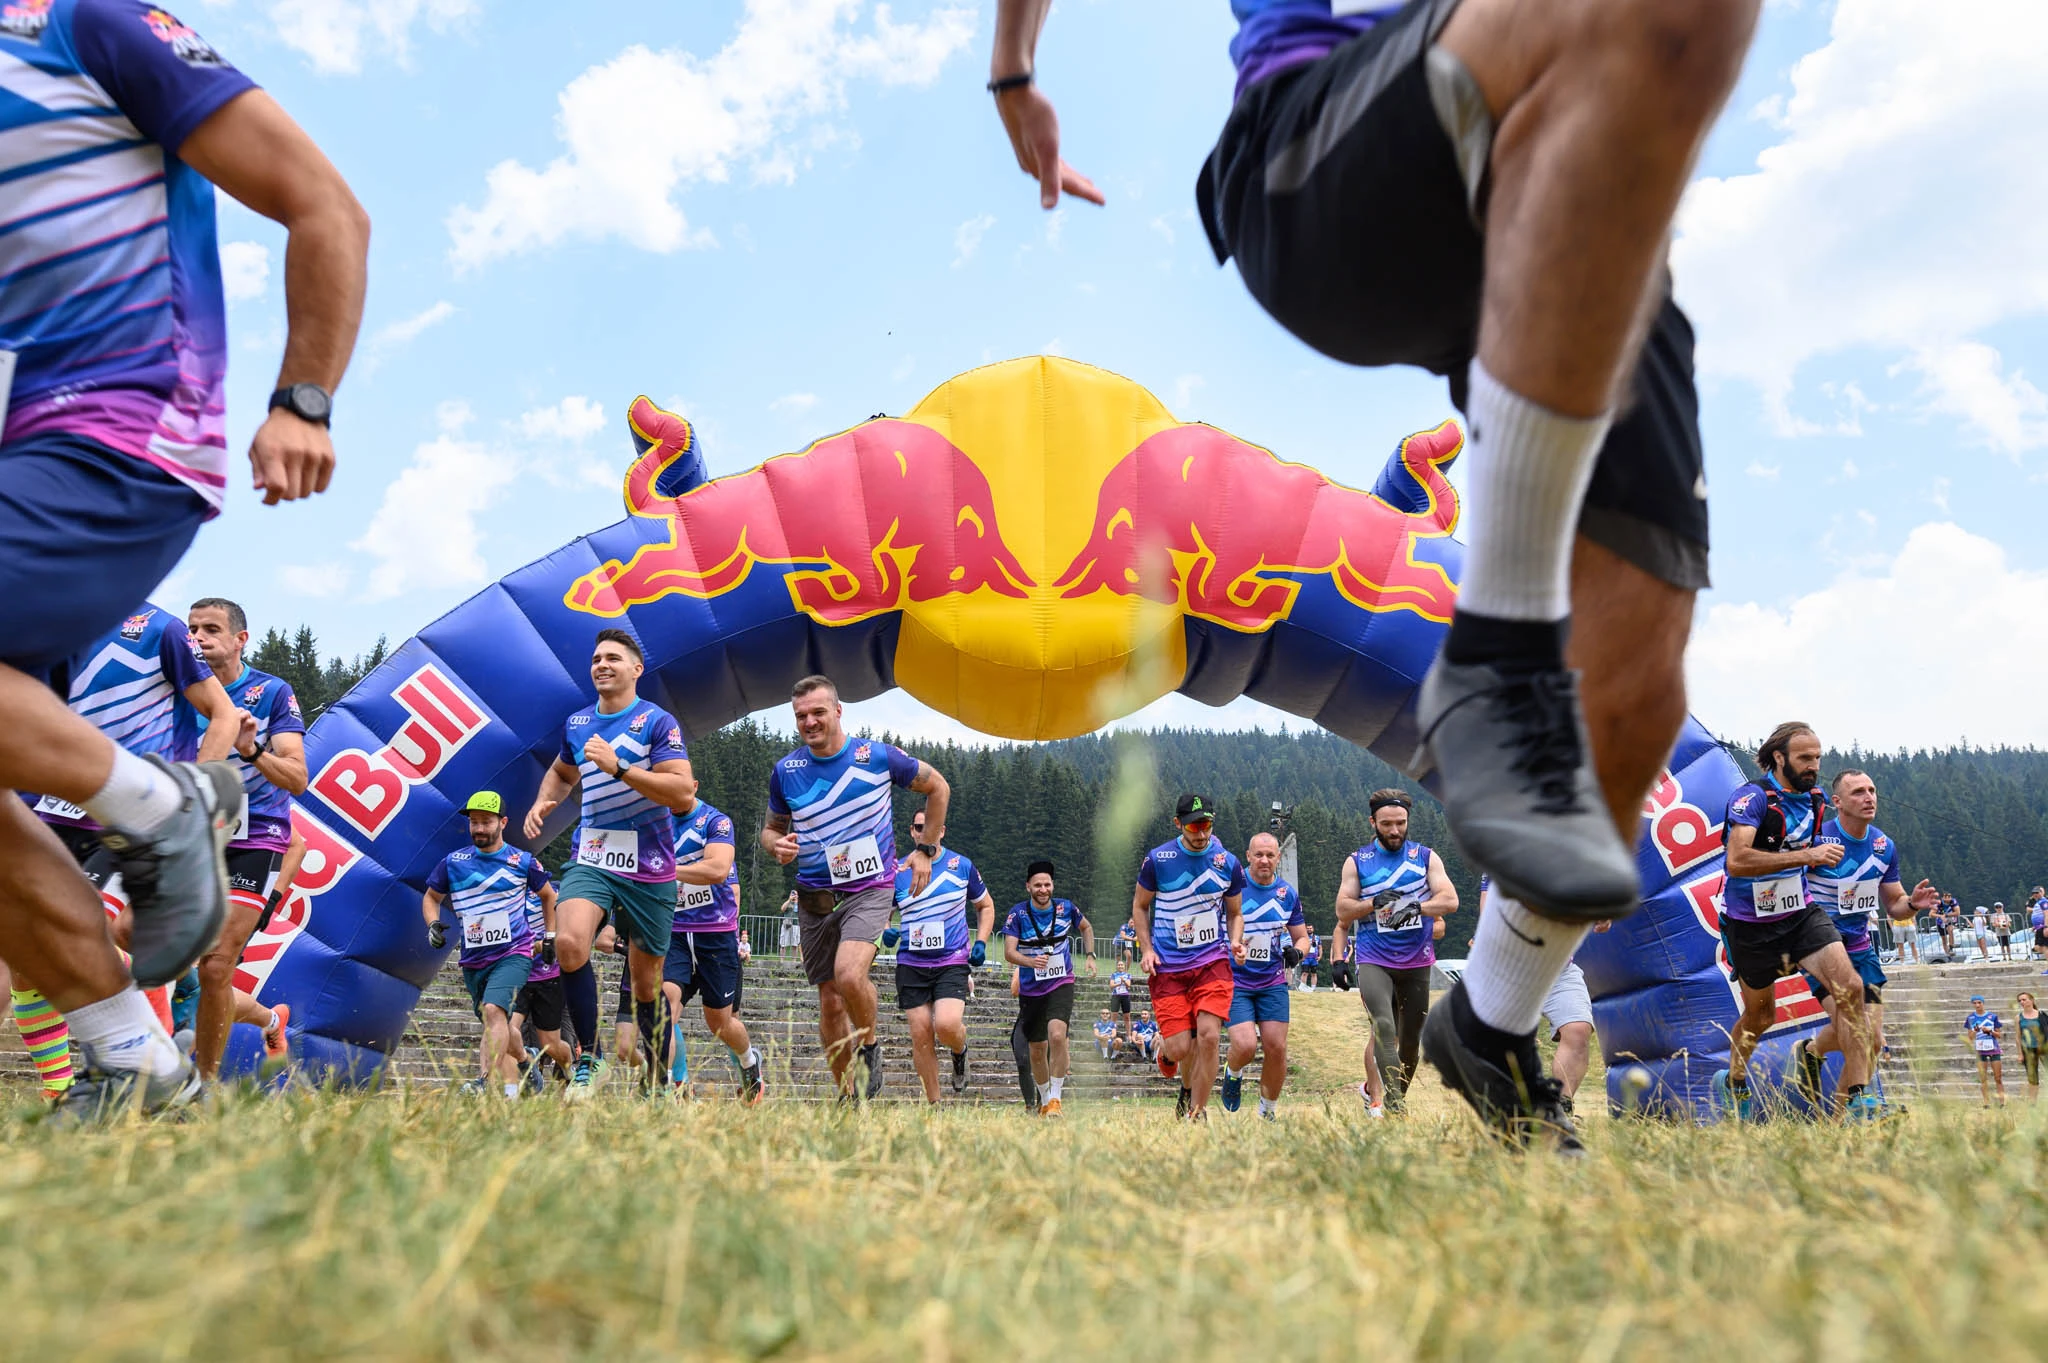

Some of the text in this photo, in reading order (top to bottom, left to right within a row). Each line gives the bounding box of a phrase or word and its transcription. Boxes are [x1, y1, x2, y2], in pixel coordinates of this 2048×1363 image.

[310, 665, 487, 837] Bull
[606, 852, 635, 868] 006
[855, 856, 879, 875] 021
[687, 889, 711, 905] 005
[1781, 894, 1800, 910] 101
[1857, 896, 1876, 909] 012
[486, 928, 509, 942] 024
[925, 936, 942, 947] 031
[1199, 928, 1215, 941] 011
[1250, 948, 1269, 959] 023
[1048, 966, 1064, 976] 007
